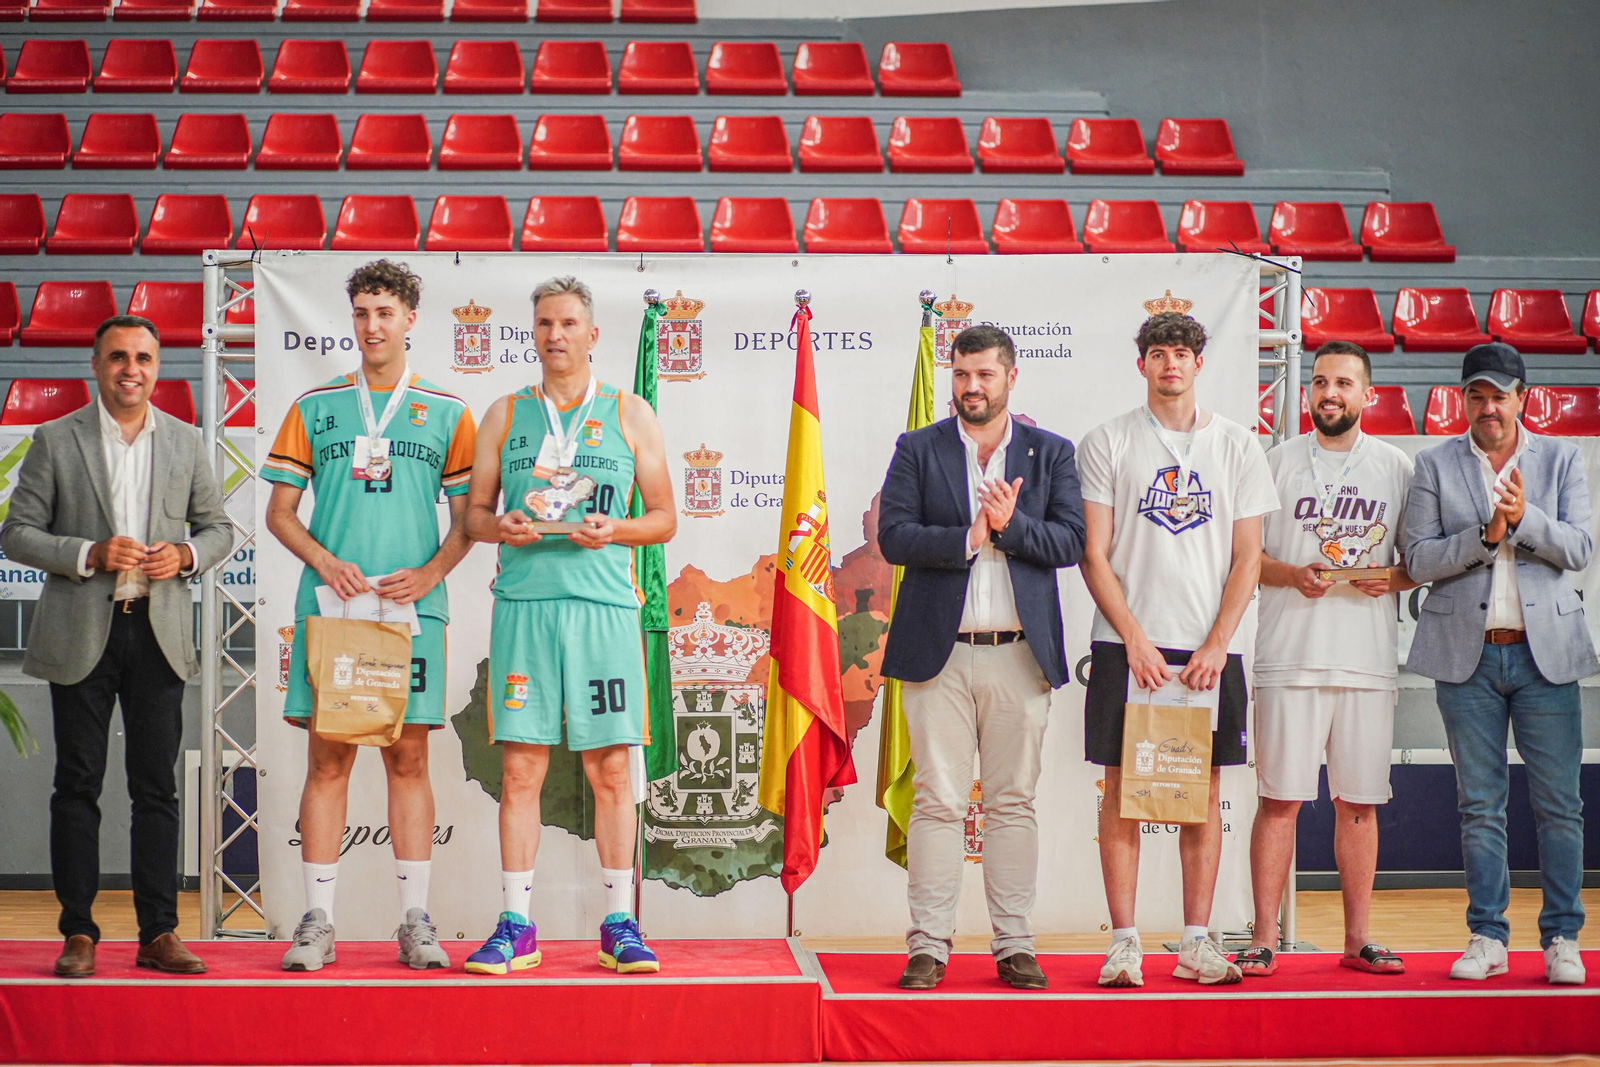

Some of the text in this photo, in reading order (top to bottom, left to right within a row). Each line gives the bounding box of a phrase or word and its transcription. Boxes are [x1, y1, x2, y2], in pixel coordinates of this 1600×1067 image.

[284, 331, 412, 356] Depos
[1014, 343, 1072, 358] ranada
[388, 440, 441, 470] AQUEROS
[509, 455, 618, 473] FUEN QUEROS
[730, 470, 786, 488] Diputa
[730, 493, 749, 508] de
[356, 667, 401, 679] Diputación
[355, 678, 400, 689] de Granada
[589, 678, 626, 715] 30
[1158, 753, 1202, 764] Diputación
[1157, 765, 1201, 775] de Granada
[681, 836, 727, 844] GRANADA
